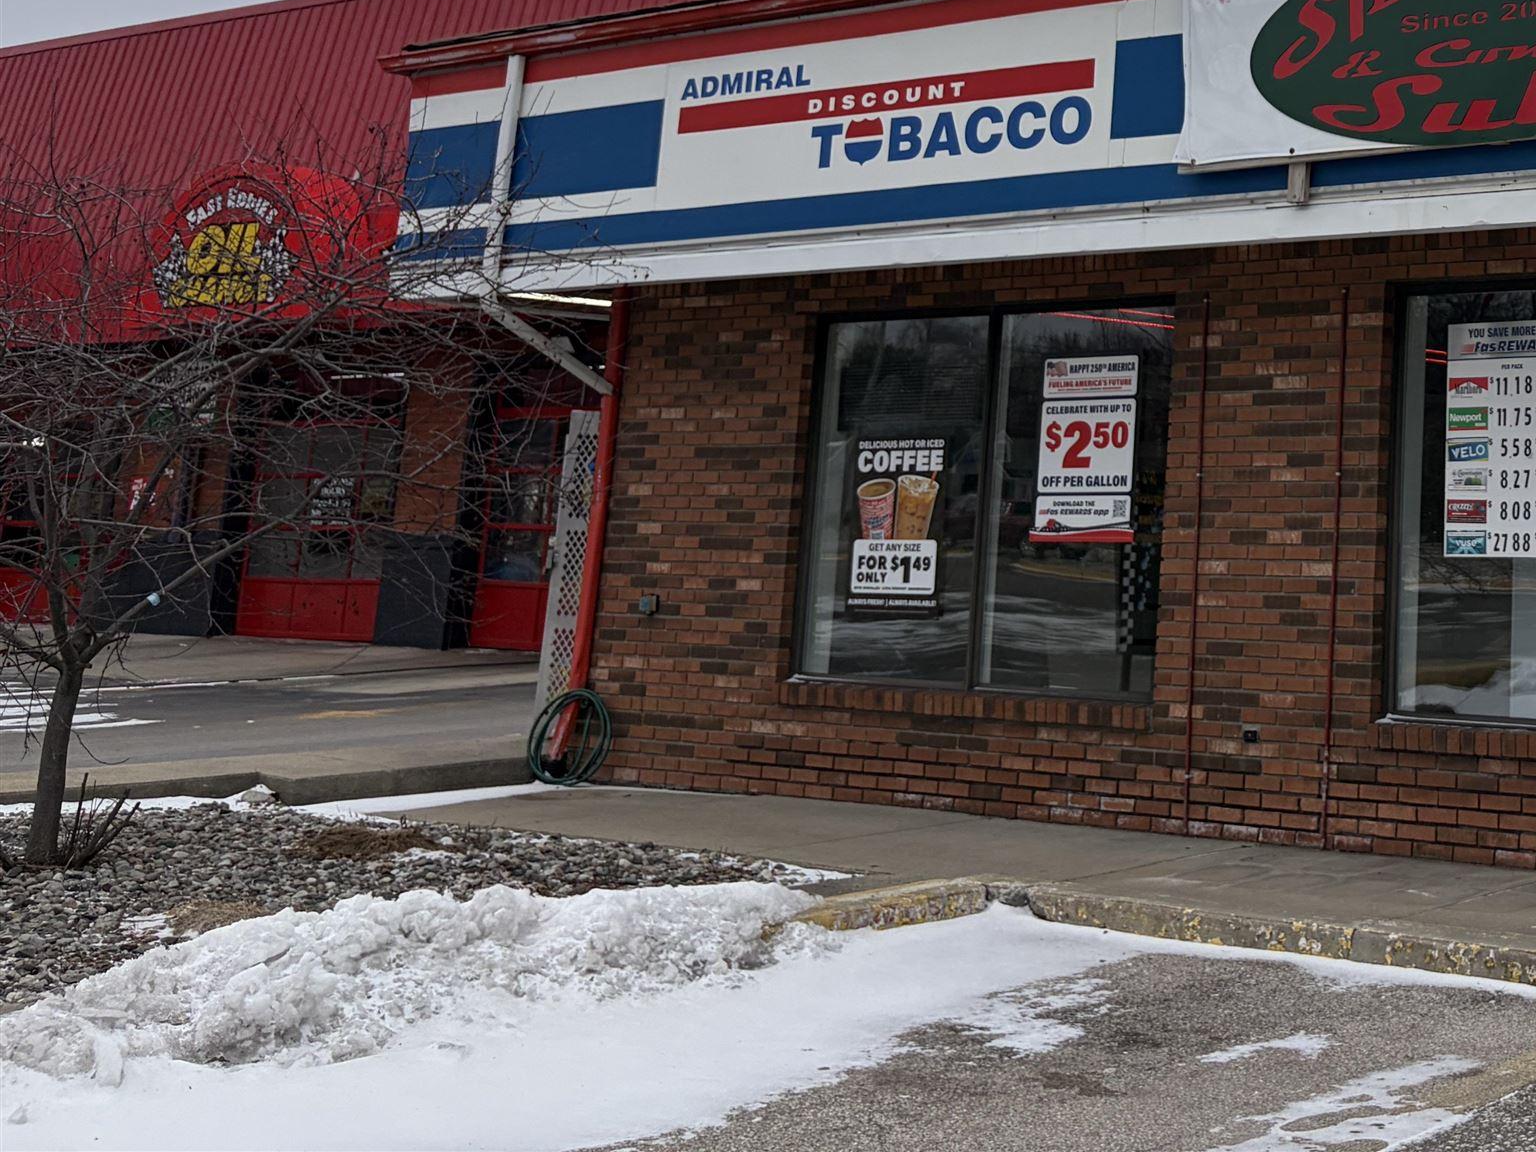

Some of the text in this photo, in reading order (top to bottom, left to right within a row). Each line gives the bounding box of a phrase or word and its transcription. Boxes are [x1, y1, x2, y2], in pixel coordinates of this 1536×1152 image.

[1401, 8, 1488, 33] Since
[1331, 49, 1384, 79] &
[681, 64, 811, 100] ADMIRAL
[808, 81, 966, 114] DISCOUNT
[187, 223, 261, 275] OIL
[1468, 328, 1485, 339] YOU
[1487, 327, 1509, 338] SAVE
[1511, 326, 1536, 336] MORE
[1069, 364, 1089, 374] HAPPY
[1107, 361, 1135, 372] AMERICA
[1048, 380, 1073, 388] FUELING
[1109, 378, 1131, 386] FUTURE
[1046, 403, 1131, 414] CELEBRATE WITH UP TO
[1449, 413, 1482, 422] Newport
[859, 439, 945, 449] DELICIOUS HOT OR ICED
[1451, 444, 1485, 459] VELO
[858, 449, 944, 473] COFFEE
[1042, 475, 1127, 487] OFF PER GALLON
[868, 543, 921, 552] GET ANY SIZE
[858, 555, 887, 569] FOR
[857, 572, 887, 583] ONLY
